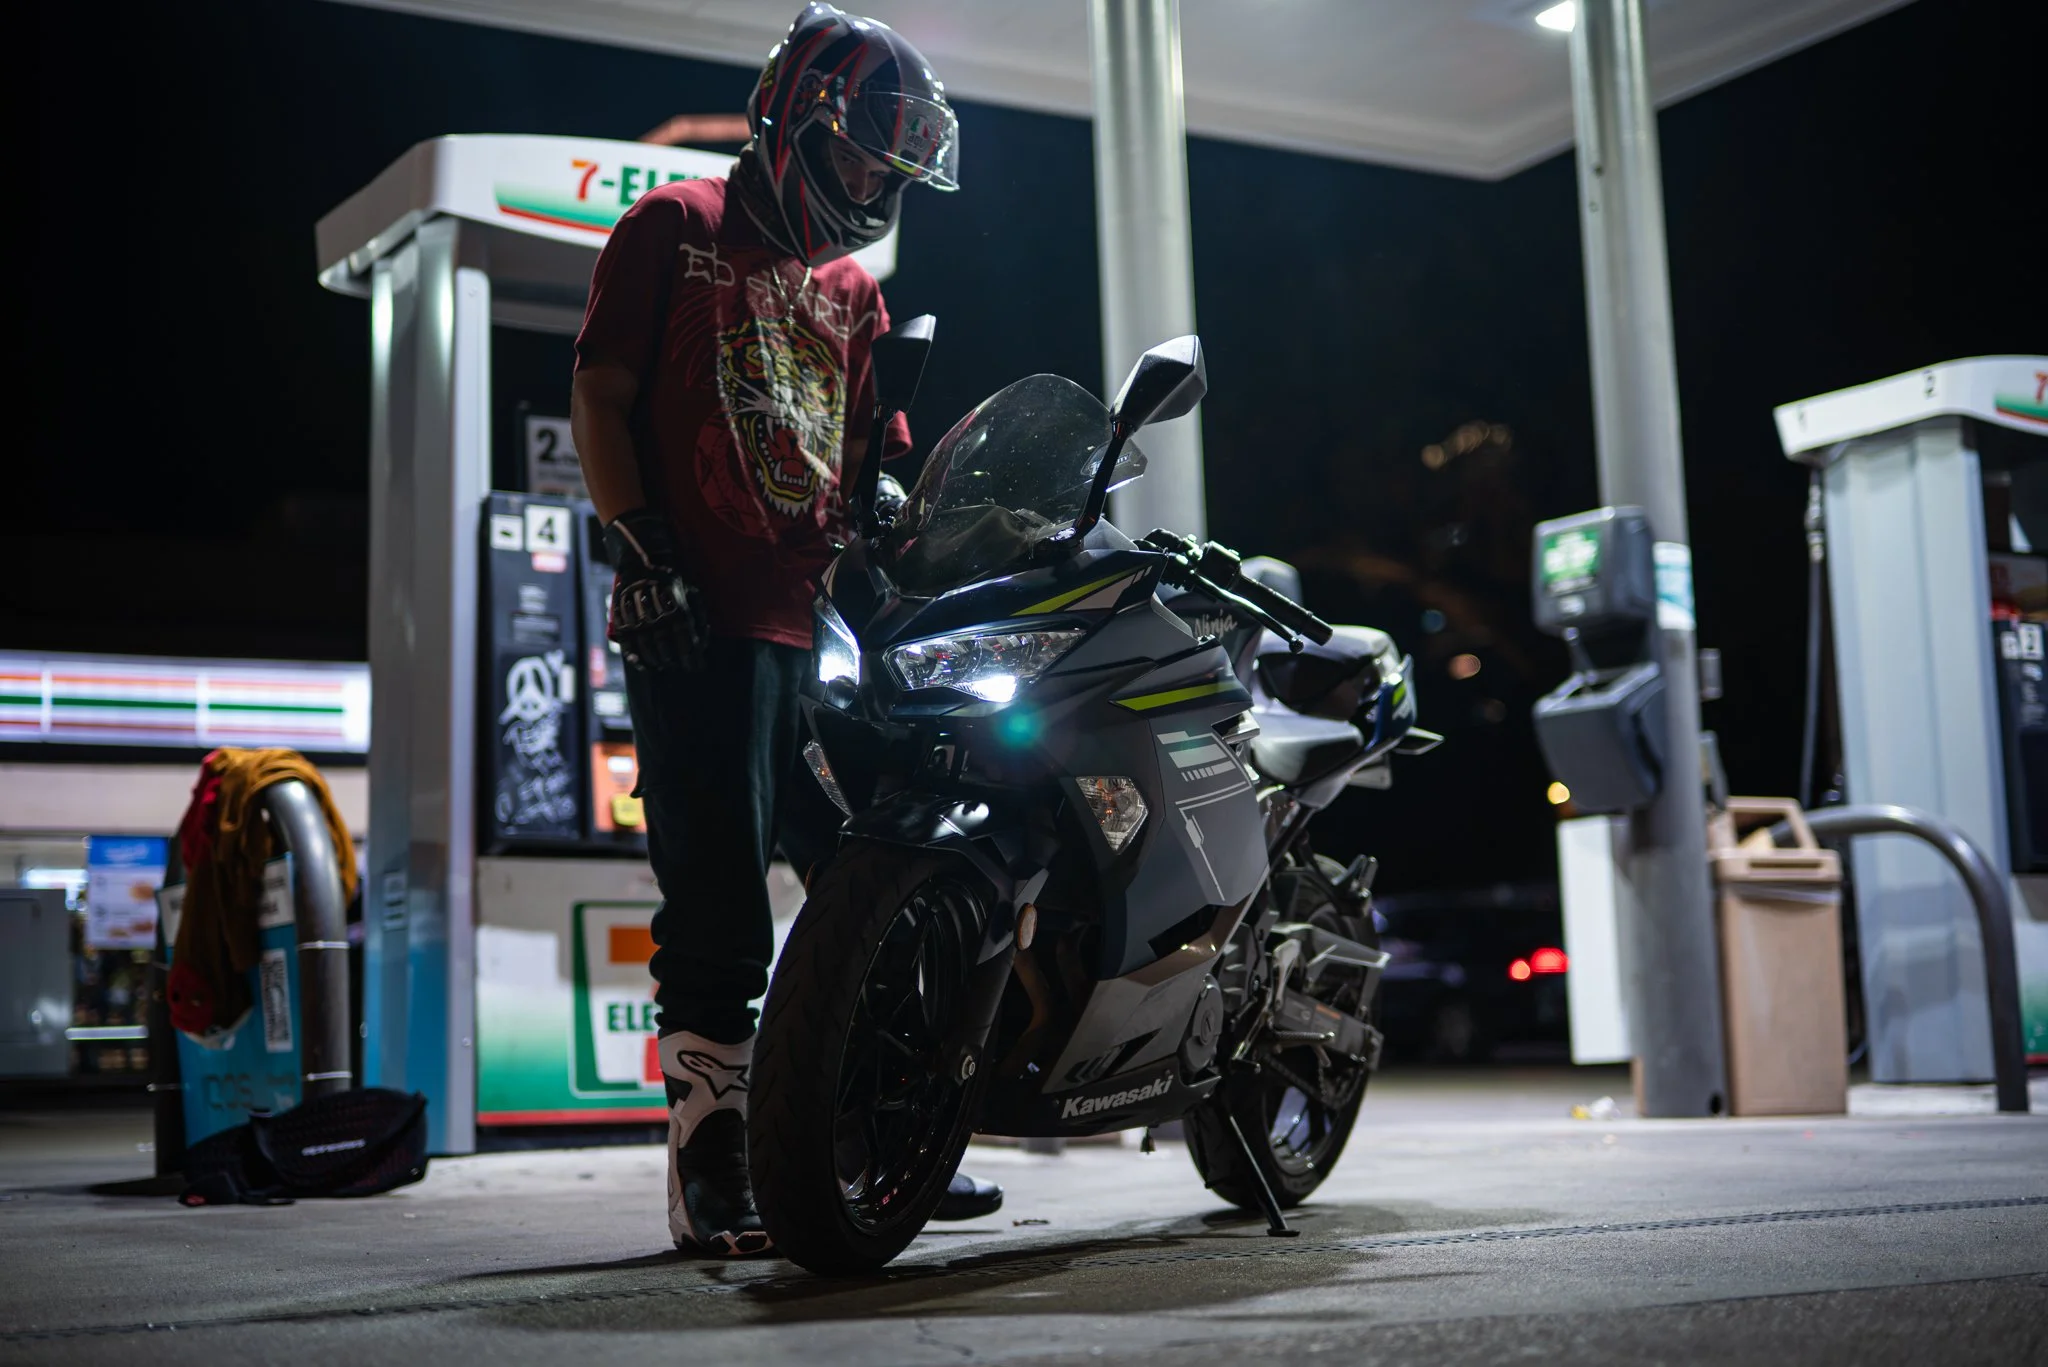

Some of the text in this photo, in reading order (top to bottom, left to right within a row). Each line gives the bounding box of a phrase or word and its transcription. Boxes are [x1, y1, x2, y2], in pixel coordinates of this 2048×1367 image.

[571, 158, 700, 207] 7-EL
[680, 242, 735, 286] ED
[537, 516, 559, 545] 4
[1194, 608, 1238, 640] Ninja
[1061, 1069, 1174, 1119] Kawasaki
